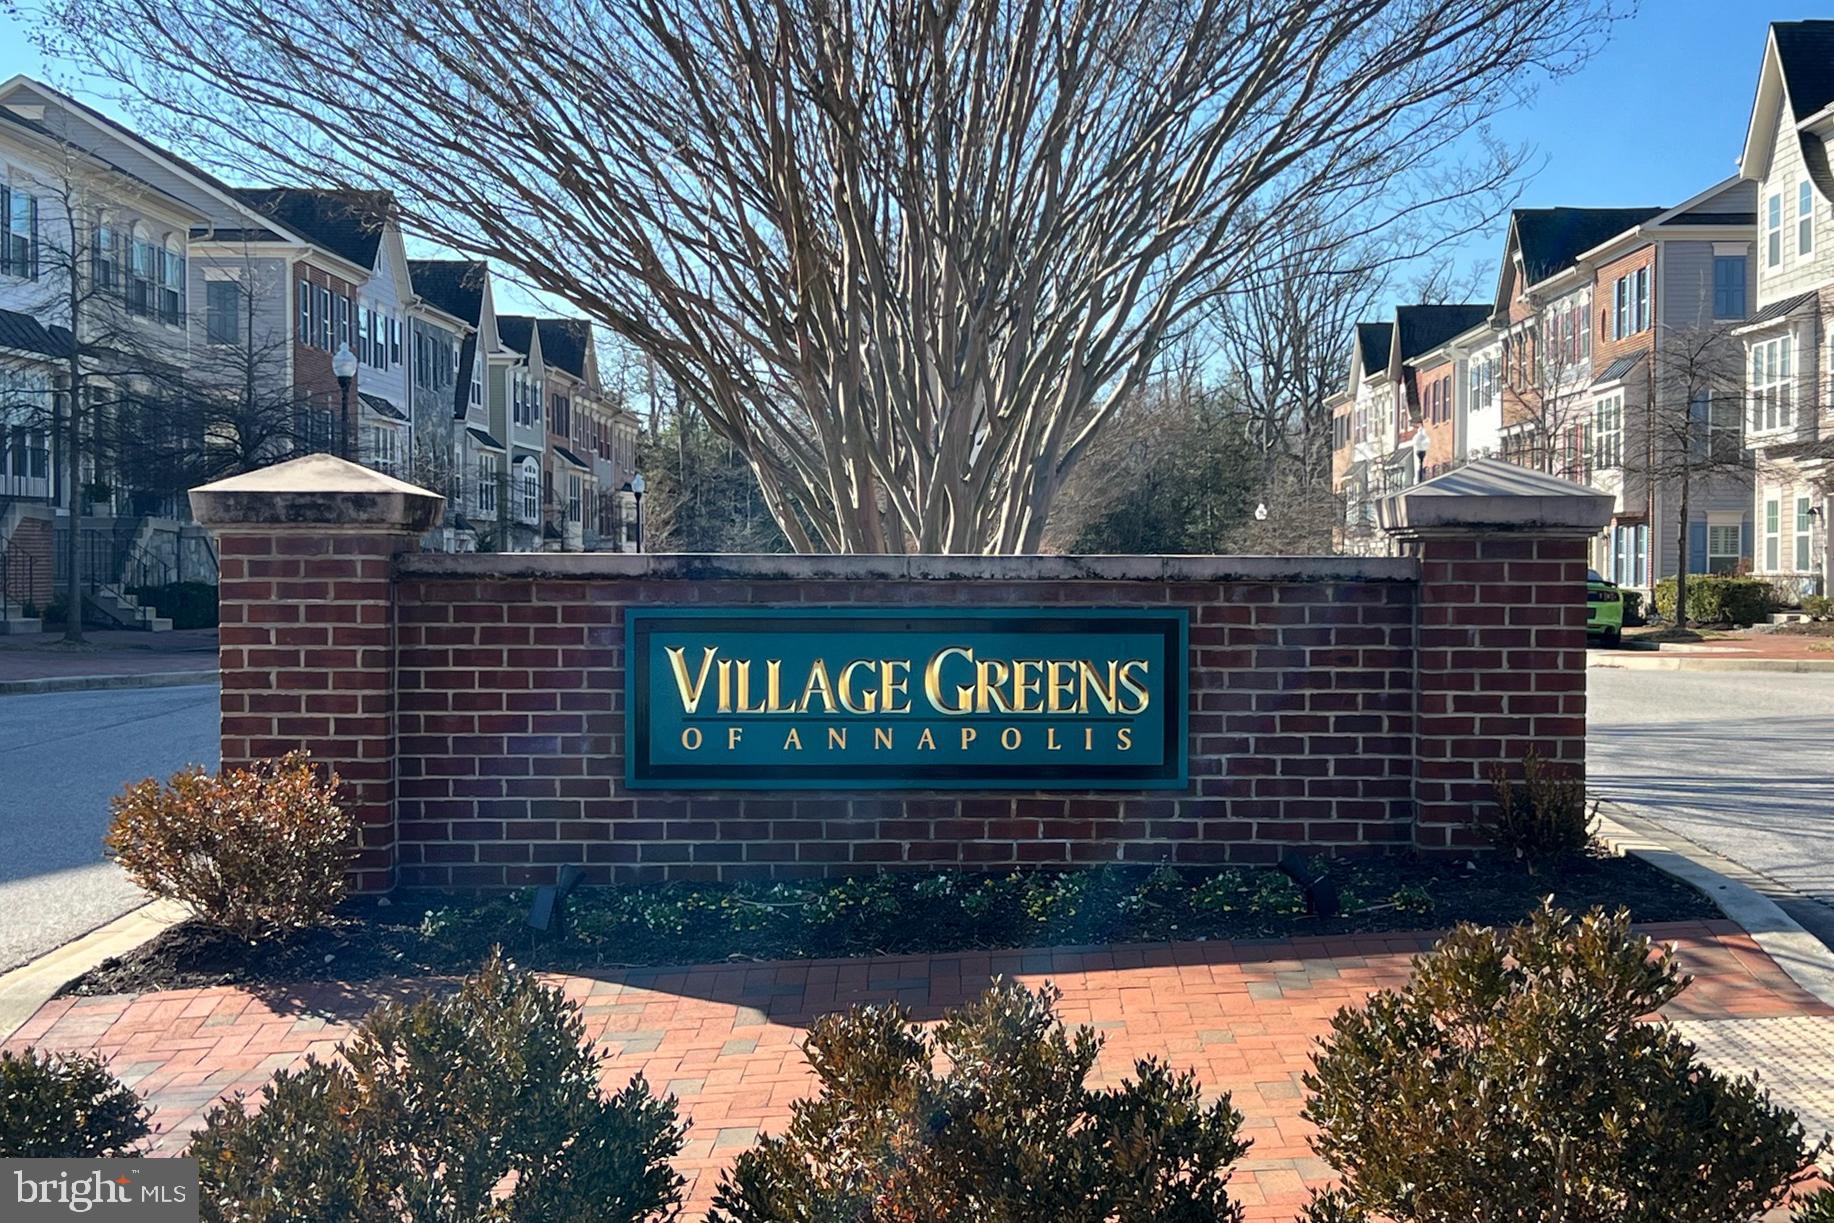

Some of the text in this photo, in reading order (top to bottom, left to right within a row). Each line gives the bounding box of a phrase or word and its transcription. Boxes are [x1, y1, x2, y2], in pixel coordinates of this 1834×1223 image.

[664, 645, 1149, 715] VILLAGE GREENS
[681, 727, 1132, 750] OF ANNAPOLIS
